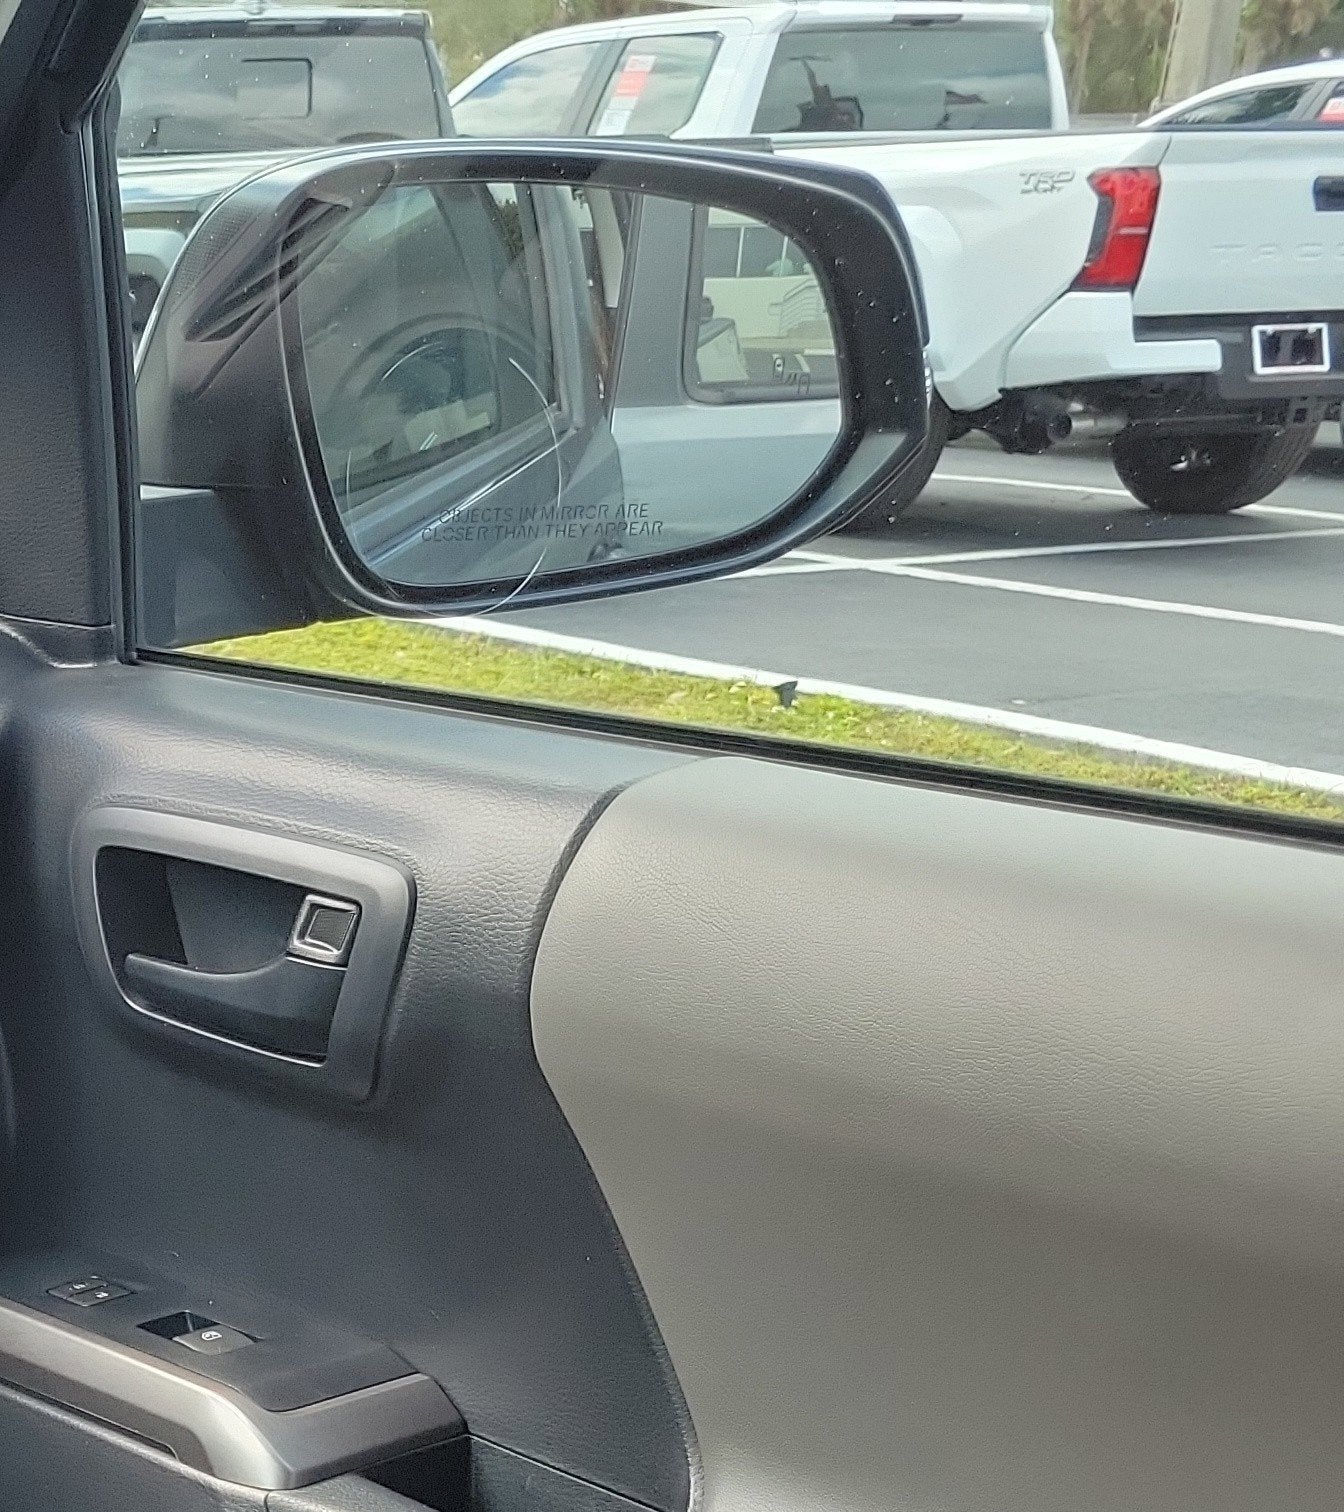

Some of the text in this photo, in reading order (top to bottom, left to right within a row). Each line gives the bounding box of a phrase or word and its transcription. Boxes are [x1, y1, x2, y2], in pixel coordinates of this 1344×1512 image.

[440, 502, 650, 524] OBJECTS IN MIRROR ARE
[421, 520, 664, 542] CLOSER THAN THEY APPEAR
